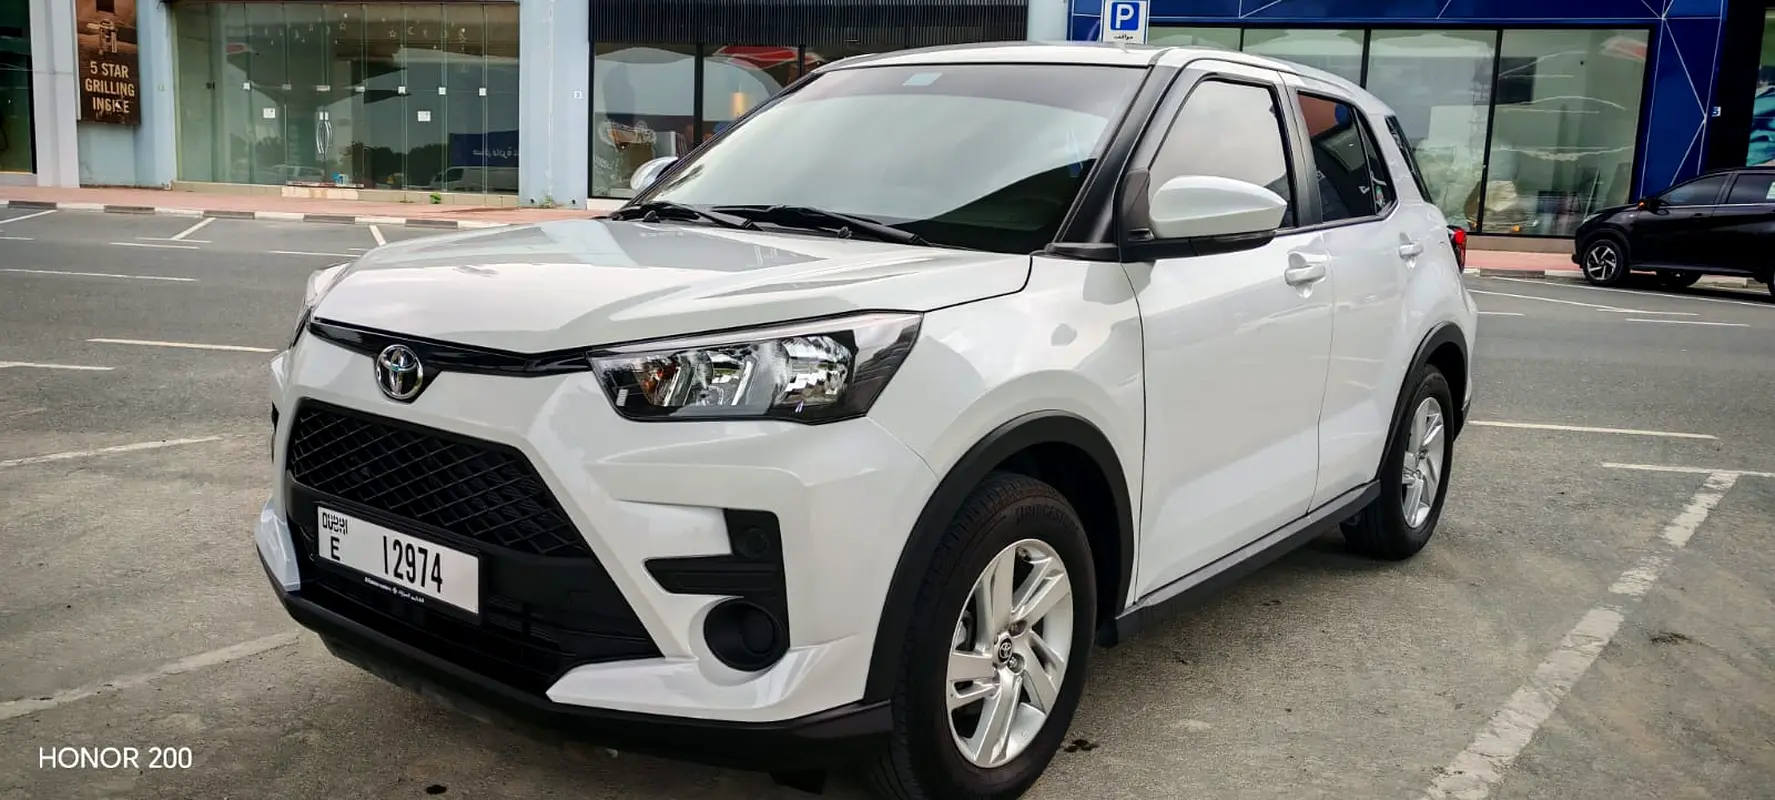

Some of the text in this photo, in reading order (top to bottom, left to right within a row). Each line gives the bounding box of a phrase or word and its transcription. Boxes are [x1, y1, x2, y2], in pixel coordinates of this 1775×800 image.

[1115, 4, 1135, 29] P
[90, 61, 129, 78] 5 STAR
[85, 78, 135, 97] GRILLING
[330, 536, 341, 560] E
[383, 535, 443, 593] 12974
